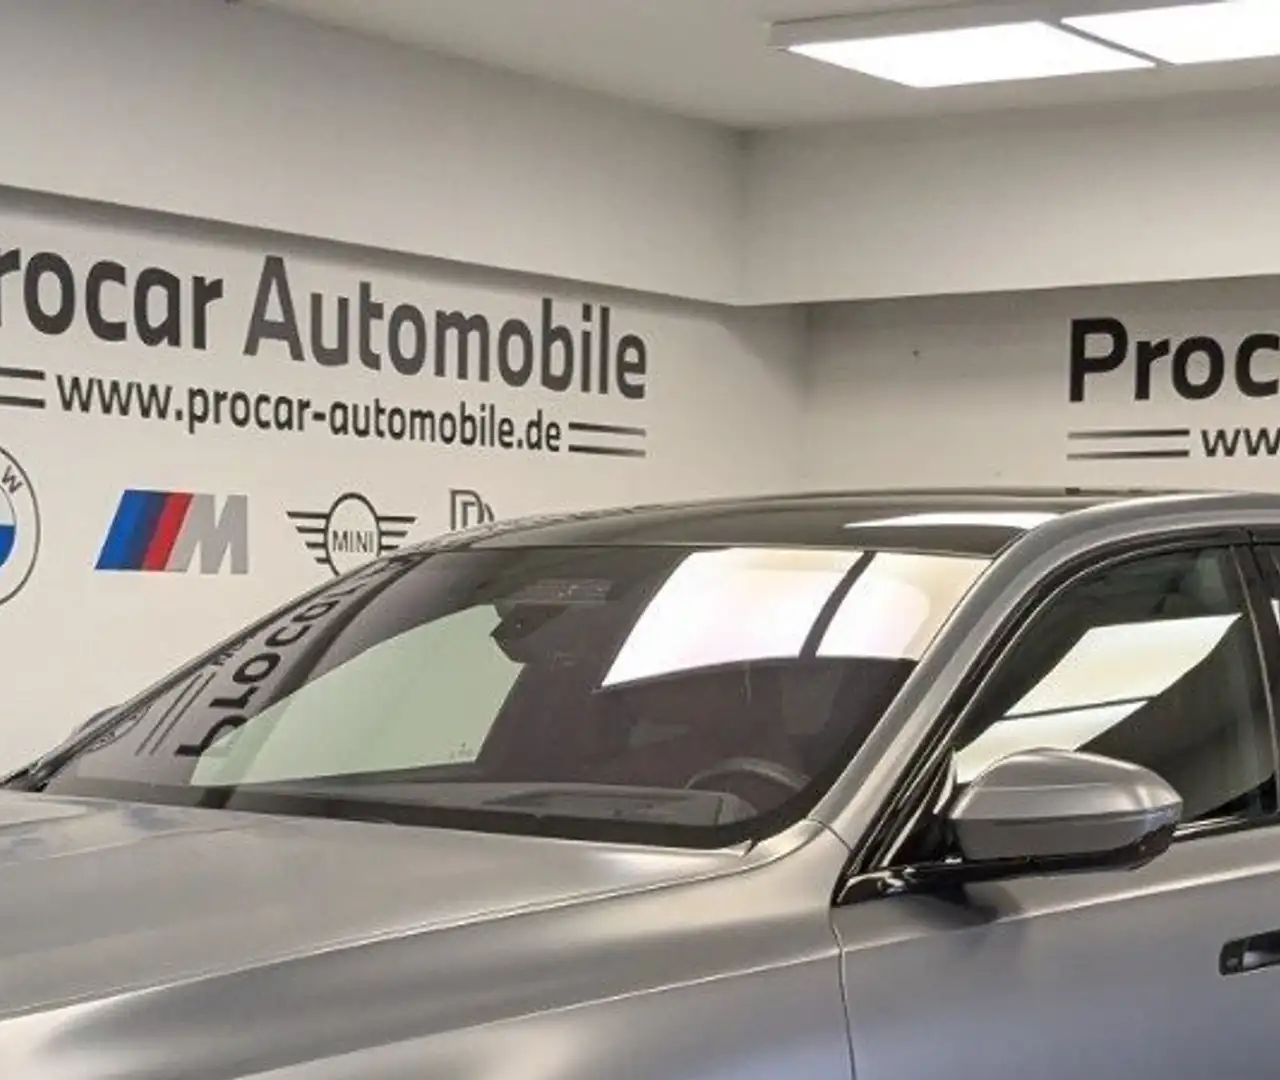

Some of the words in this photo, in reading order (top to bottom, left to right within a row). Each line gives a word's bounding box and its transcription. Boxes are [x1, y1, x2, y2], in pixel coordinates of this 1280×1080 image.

[242, 254, 648, 400] Automobile
[55, 373, 563, 454] www.procar-automobile.de
[331, 528, 376, 555] MINI
